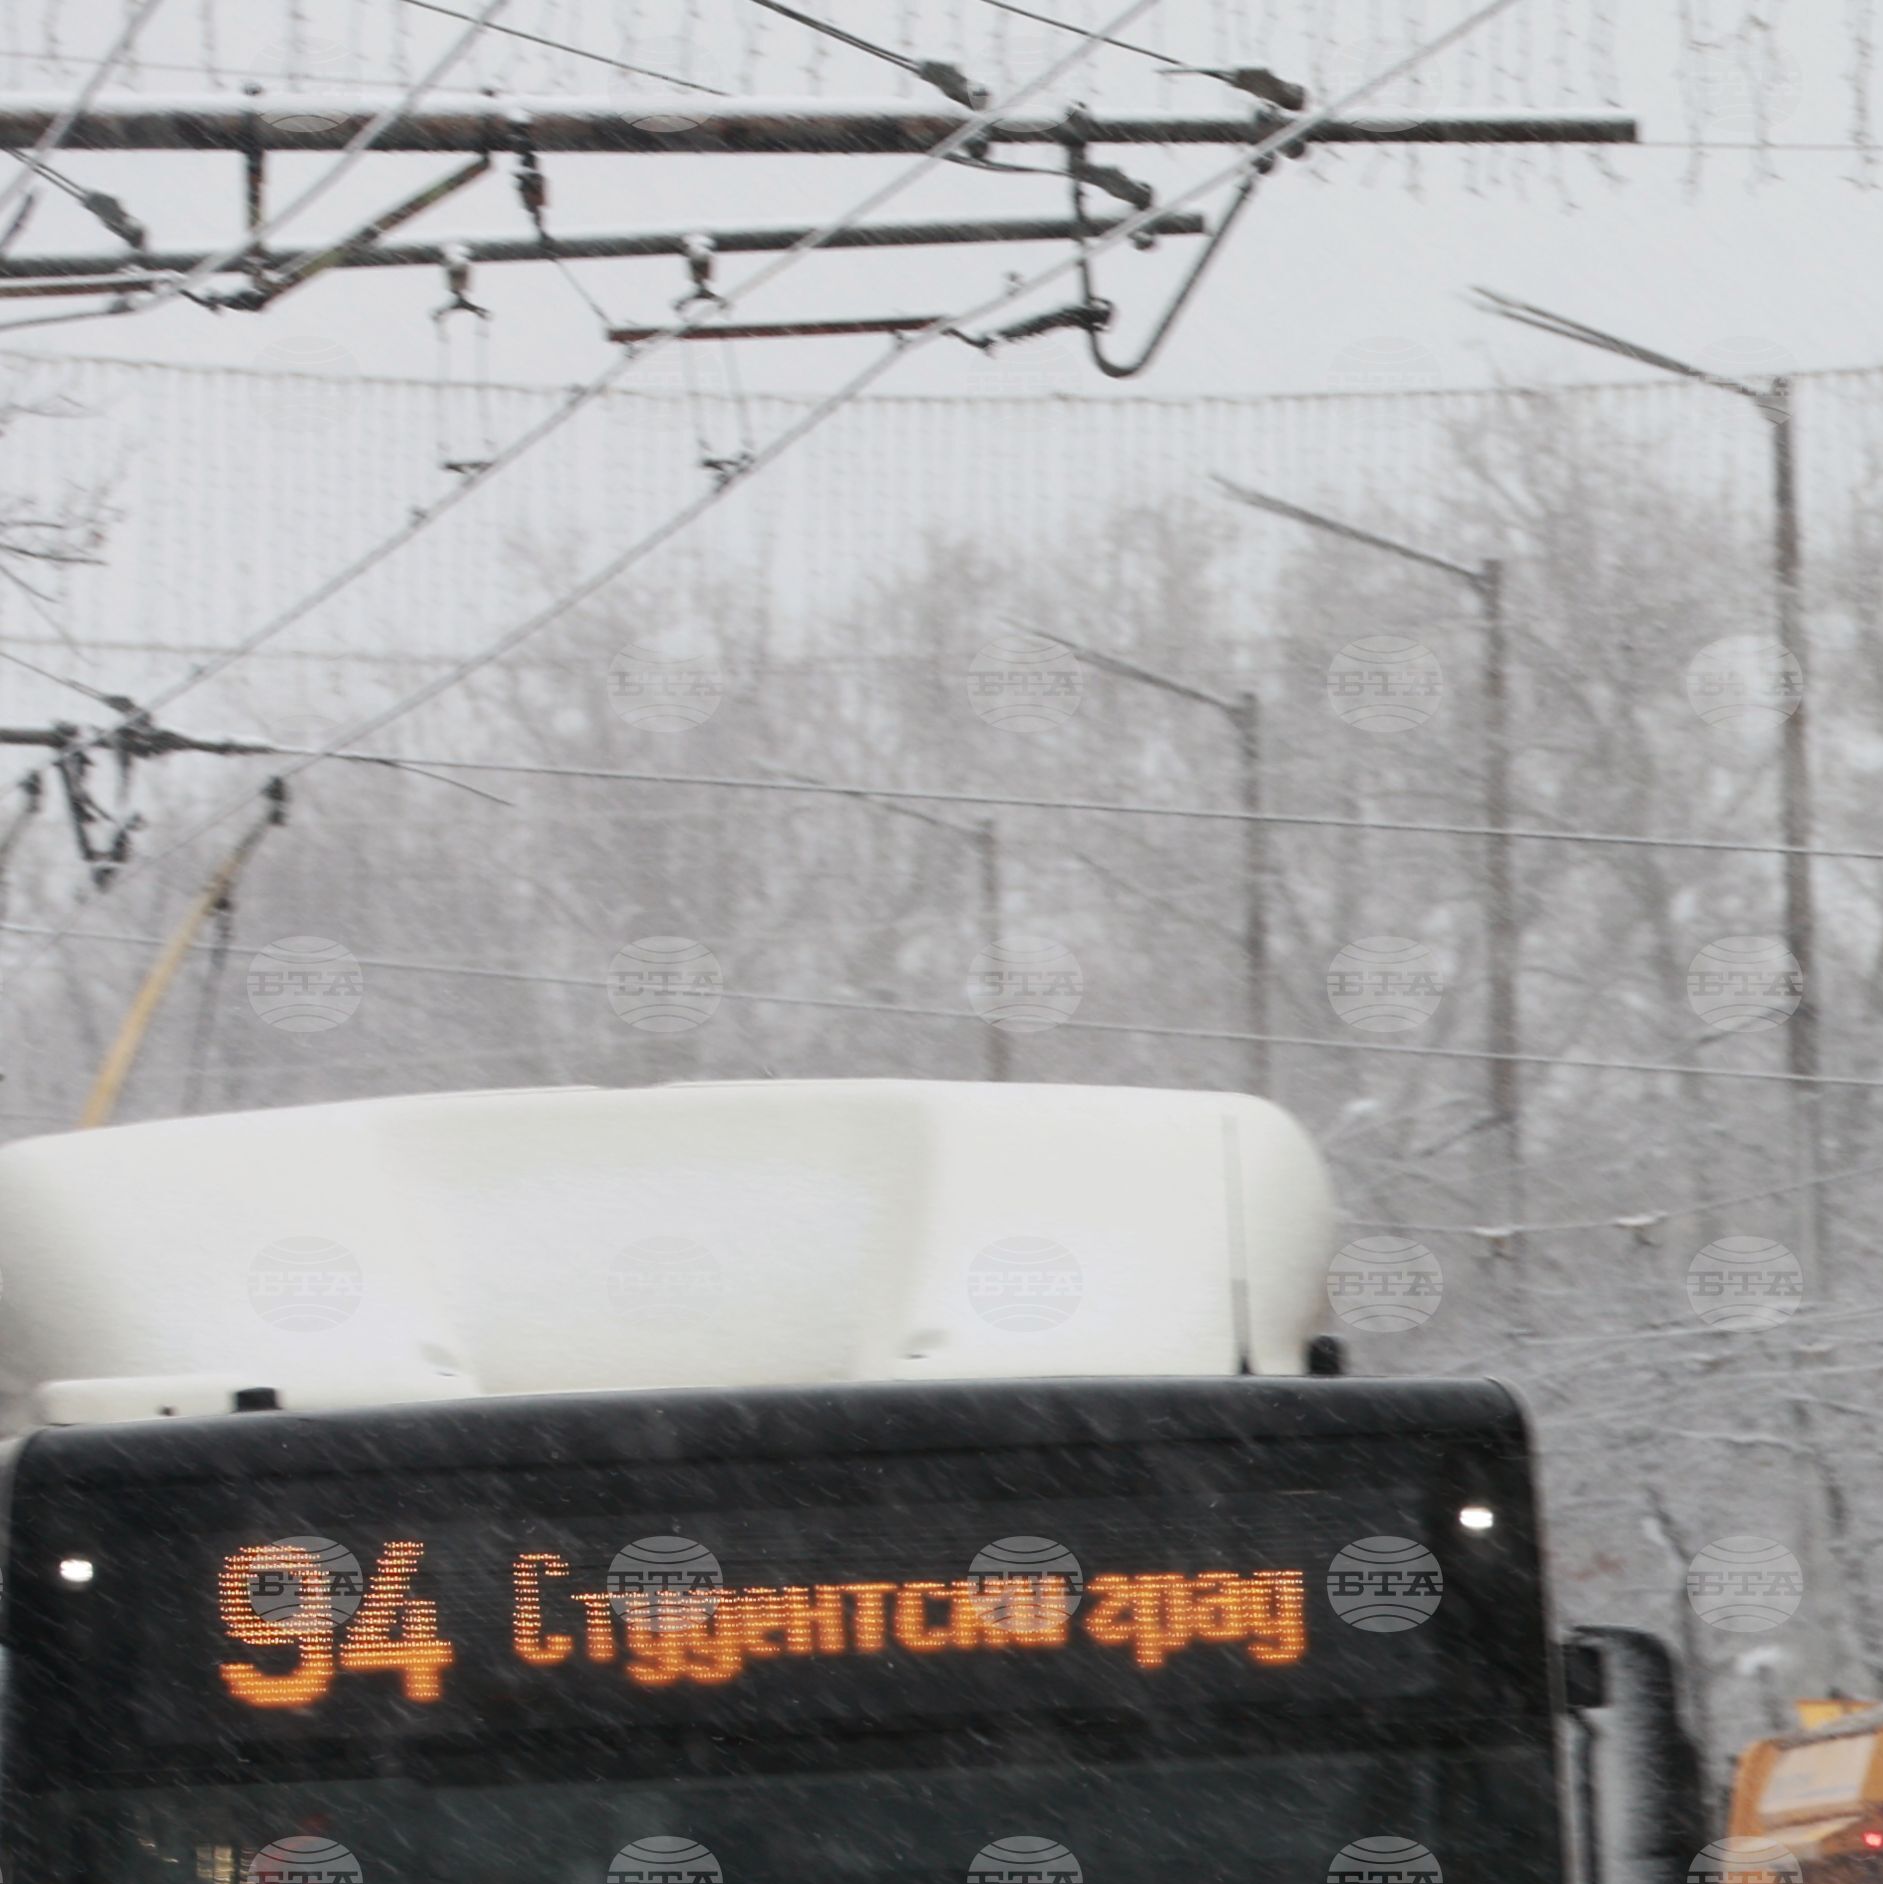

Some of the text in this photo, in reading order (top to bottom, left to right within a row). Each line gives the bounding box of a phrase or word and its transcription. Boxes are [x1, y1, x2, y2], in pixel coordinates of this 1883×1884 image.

[218, 1541, 1305, 1706] 94 Студентски град
